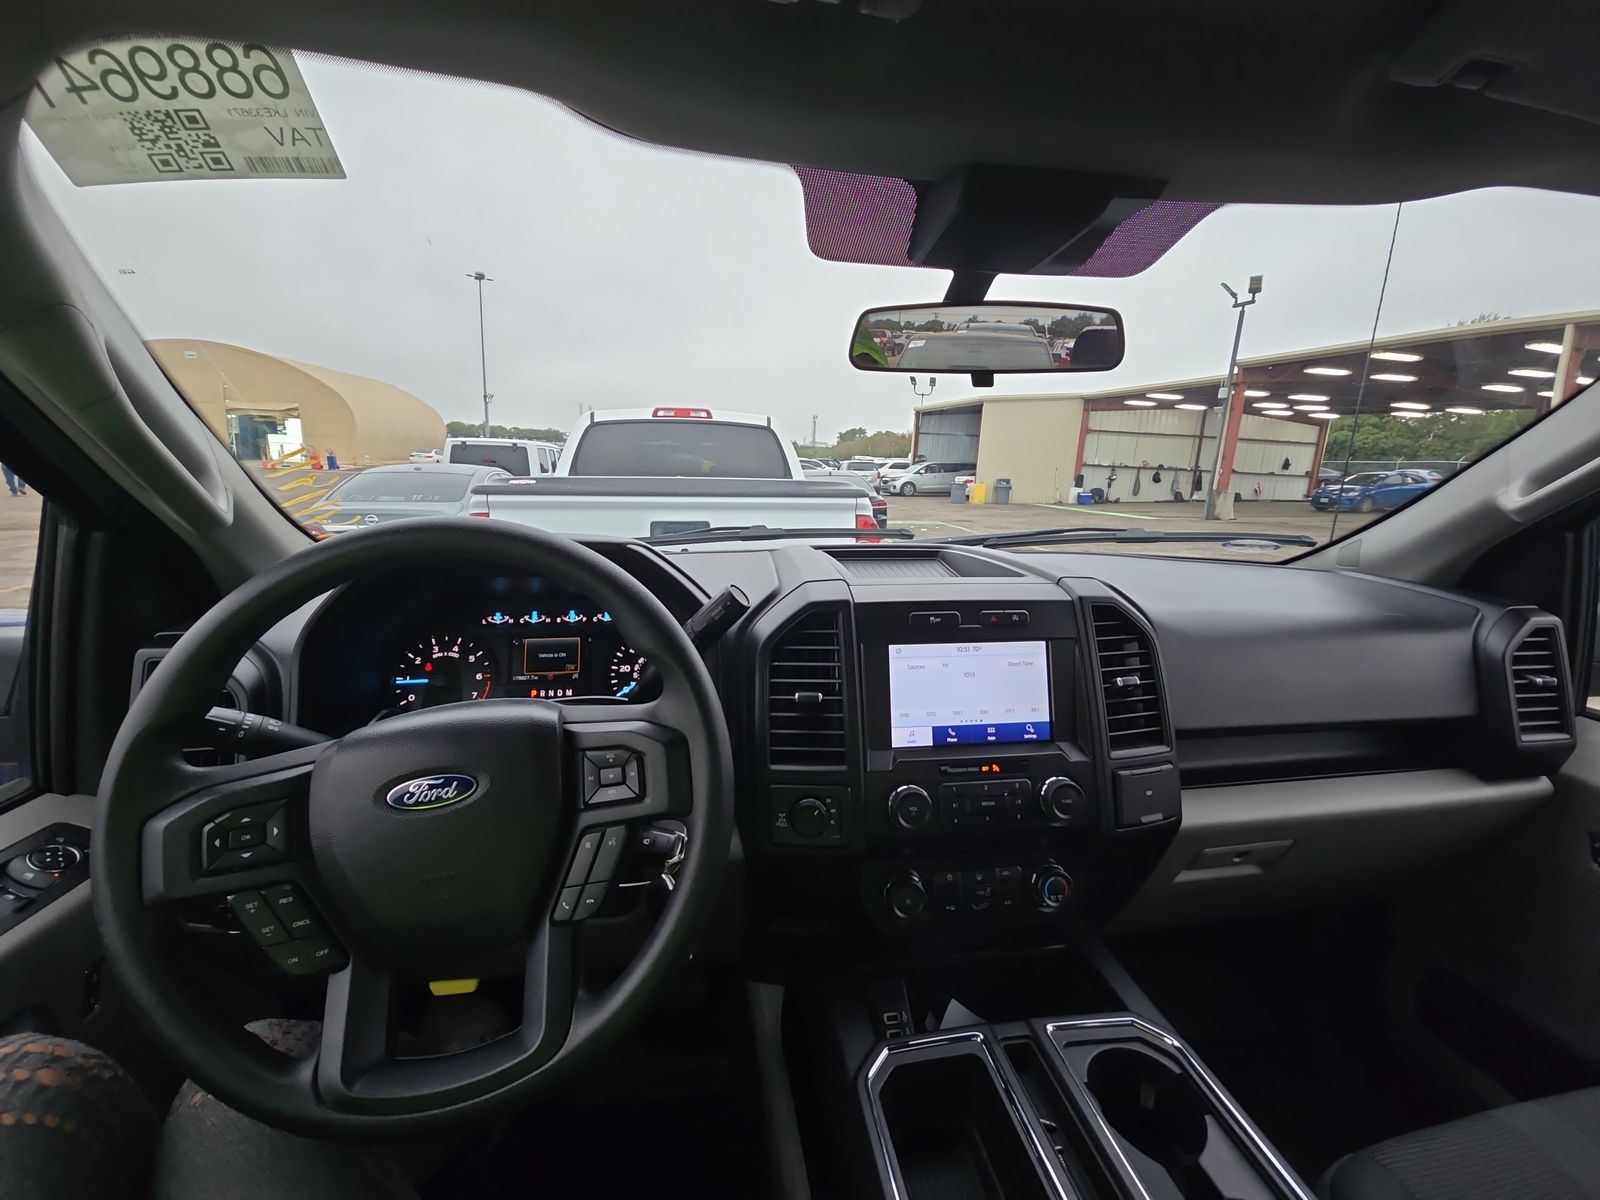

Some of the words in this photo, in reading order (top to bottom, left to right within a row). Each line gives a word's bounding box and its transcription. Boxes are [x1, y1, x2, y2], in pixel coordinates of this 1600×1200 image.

[619, 665, 631, 673] 20
[408, 694, 416, 702] 0
[403, 778, 458, 805] Ford
[245, 902, 258, 910] SET
[262, 925, 275, 934] SET
[292, 919, 311, 928] CNCL
[315, 948, 329, 957] OFF
